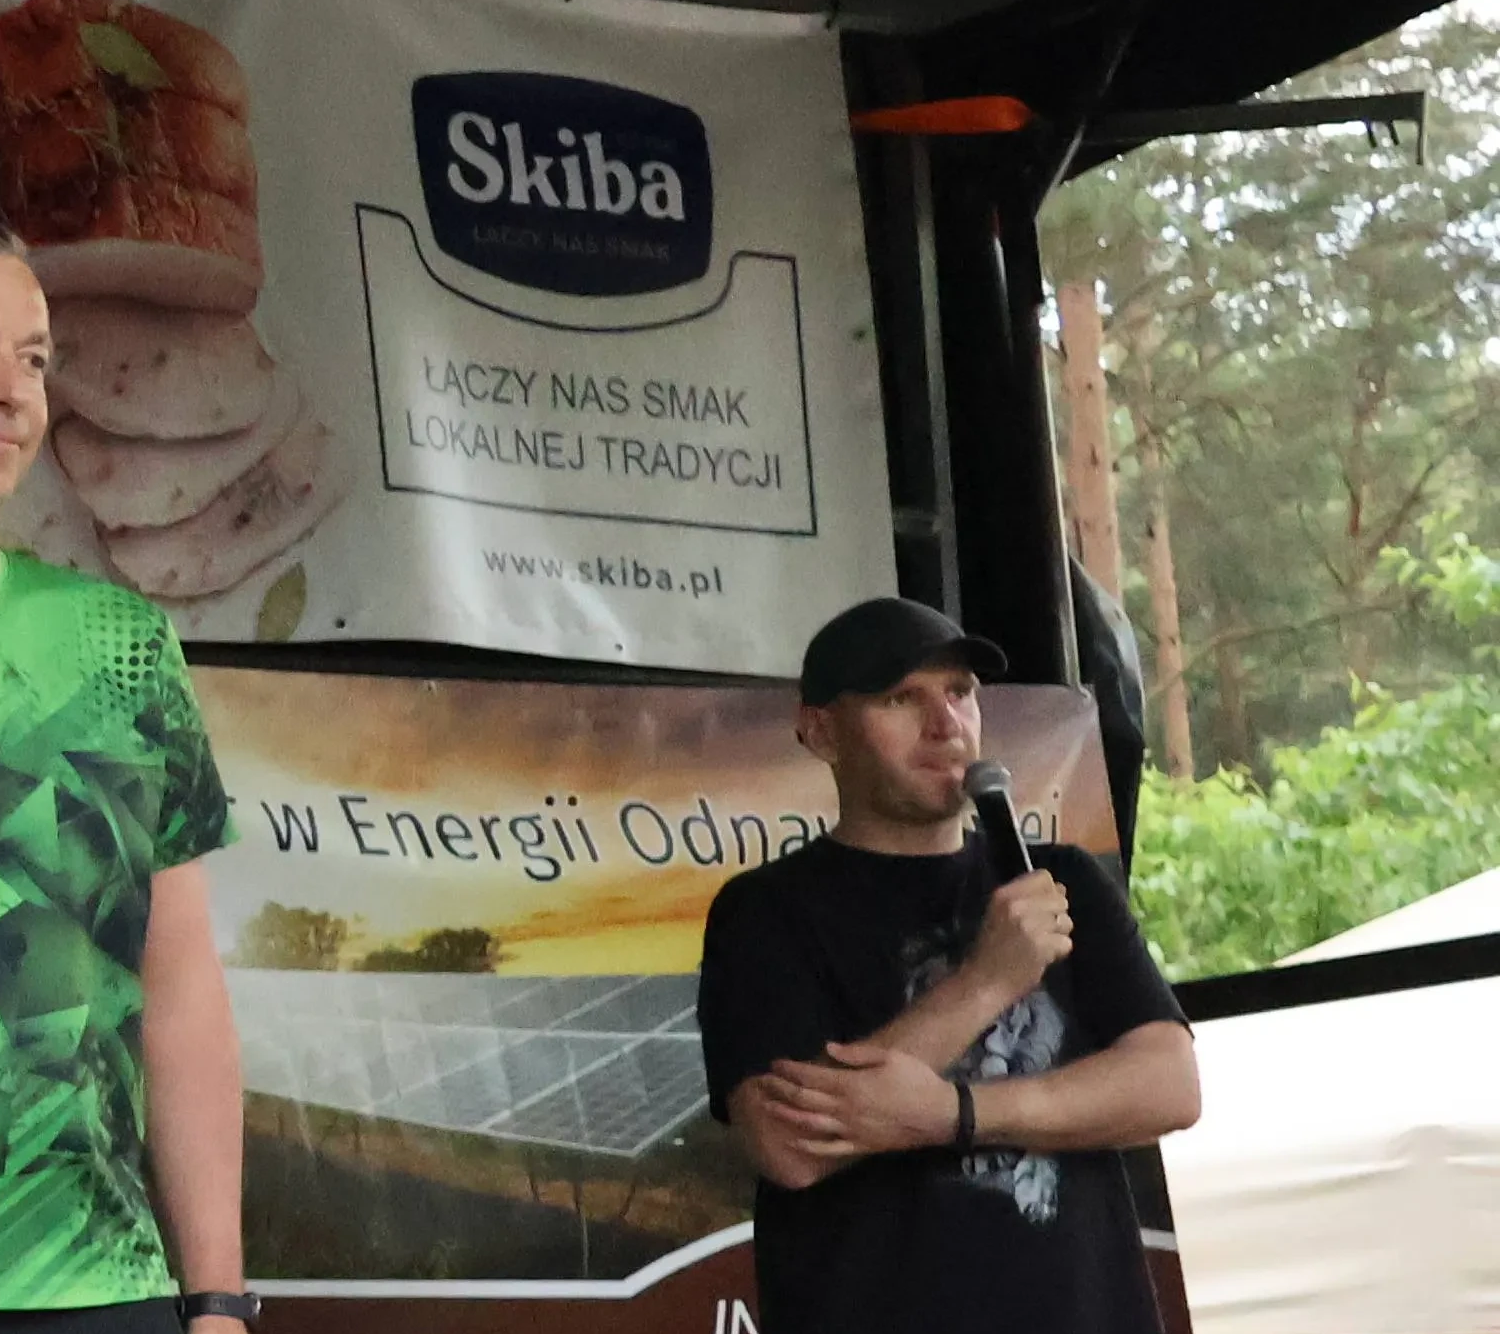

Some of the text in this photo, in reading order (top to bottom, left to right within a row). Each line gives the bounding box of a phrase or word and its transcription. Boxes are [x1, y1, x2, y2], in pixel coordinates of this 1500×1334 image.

[446, 110, 686, 222] Skiba
[423, 355, 750, 428] ŁĄCZY NAS SMAK
[405, 409, 781, 491] LOKALNEJ TRADYCJI
[482, 549, 724, 599] www.skiba.pl
[262, 801, 320, 855] w
[338, 794, 599, 884] Energii
